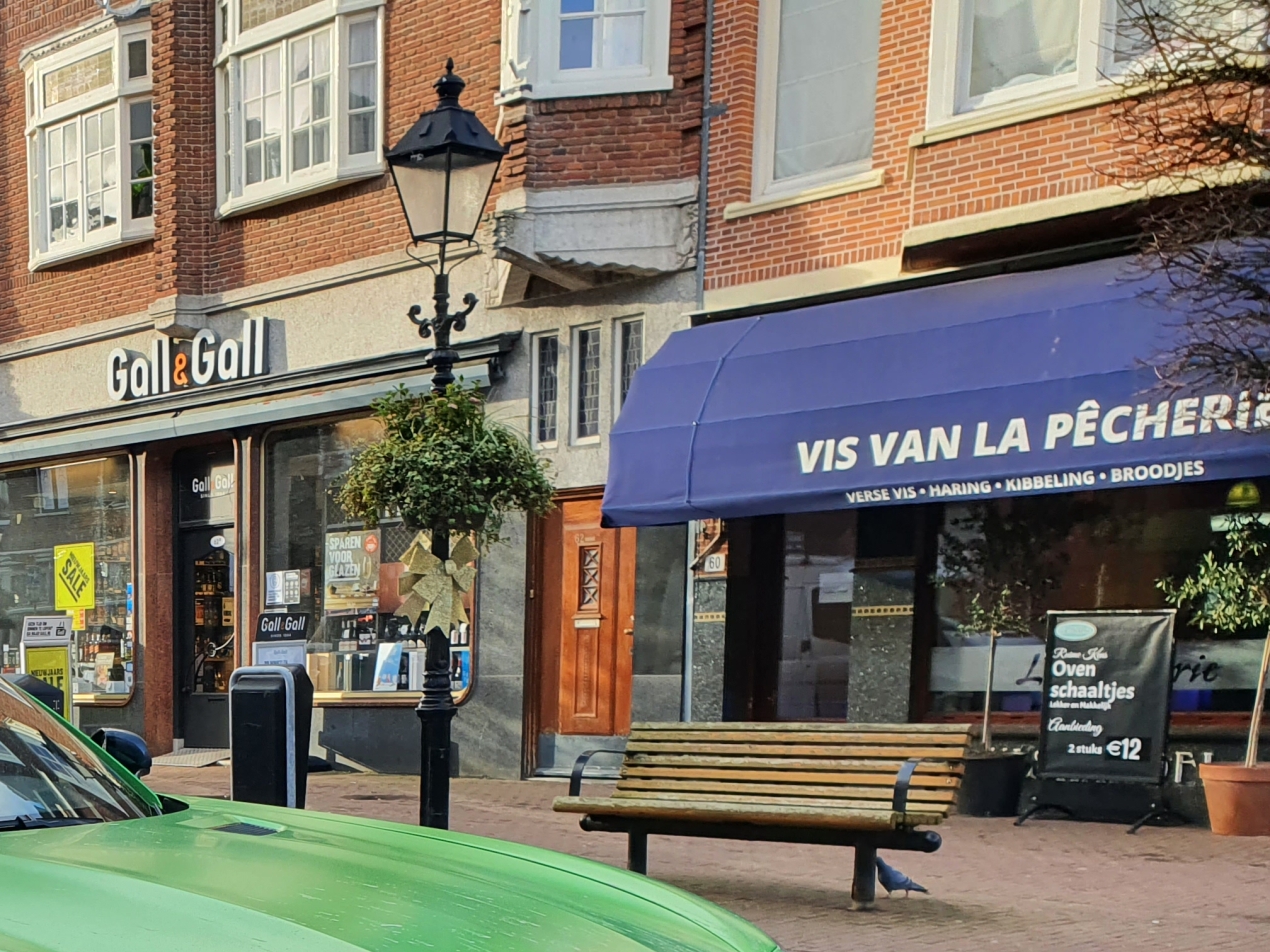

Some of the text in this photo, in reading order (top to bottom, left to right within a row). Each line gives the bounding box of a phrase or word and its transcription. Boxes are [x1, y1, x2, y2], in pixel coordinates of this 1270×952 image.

[796, 436, 860, 474] VIS
[869, 424, 962, 467] VAN
[973, 417, 1030, 457] LA
[846, 460, 1205, 503] VERSE VIS HARING KIBBELING BROODJES
[330, 536, 361, 550] SPAREN
[329, 550, 353, 564] VOOR
[709, 556, 721, 569] 60
[62, 558, 87, 599] SALE
[329, 563, 360, 577] GLAZEN
[31, 668, 64, 676] NIEUWJAARS
[1052, 660, 1096, 677] Oven
[1049, 680, 1135, 703] schaaltjes
[1048, 717, 1104, 737] Aanbieding
[1068, 738, 1142, 760] 2 stuks €12
